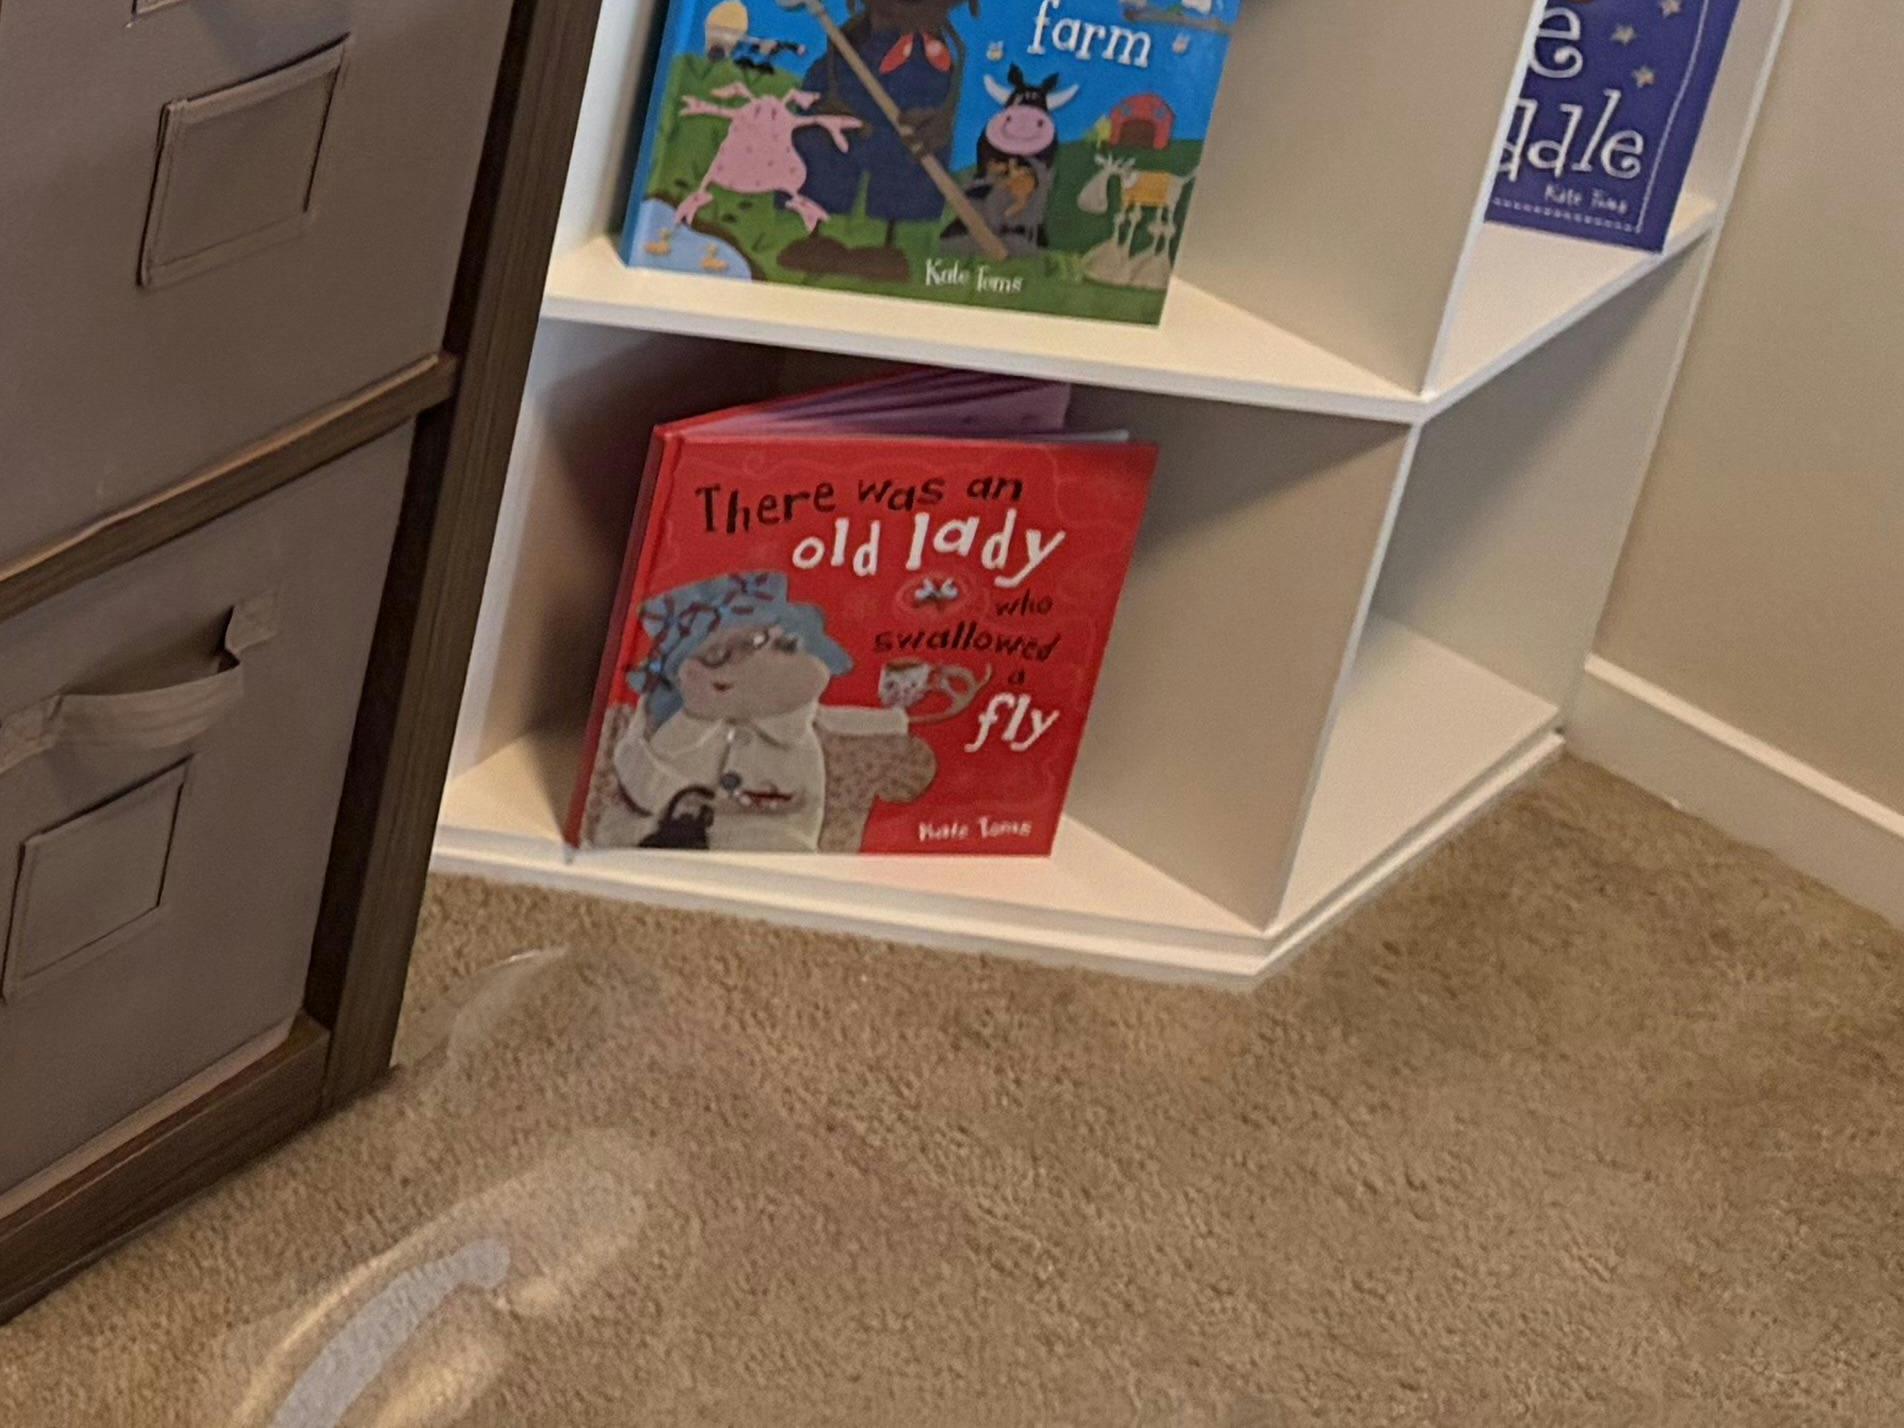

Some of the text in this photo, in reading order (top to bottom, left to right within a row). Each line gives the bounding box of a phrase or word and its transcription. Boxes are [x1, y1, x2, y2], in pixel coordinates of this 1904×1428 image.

[1498, 89, 1644, 181] ddle
[925, 258, 1023, 294] Kate Toms
[695, 475, 1023, 535] There was an
[792, 507, 1066, 587] old lady
[993, 587, 1053, 618] who
[872, 620, 1061, 662] swallowed
[1006, 668, 1025, 687] a
[964, 693, 1059, 753] fly
